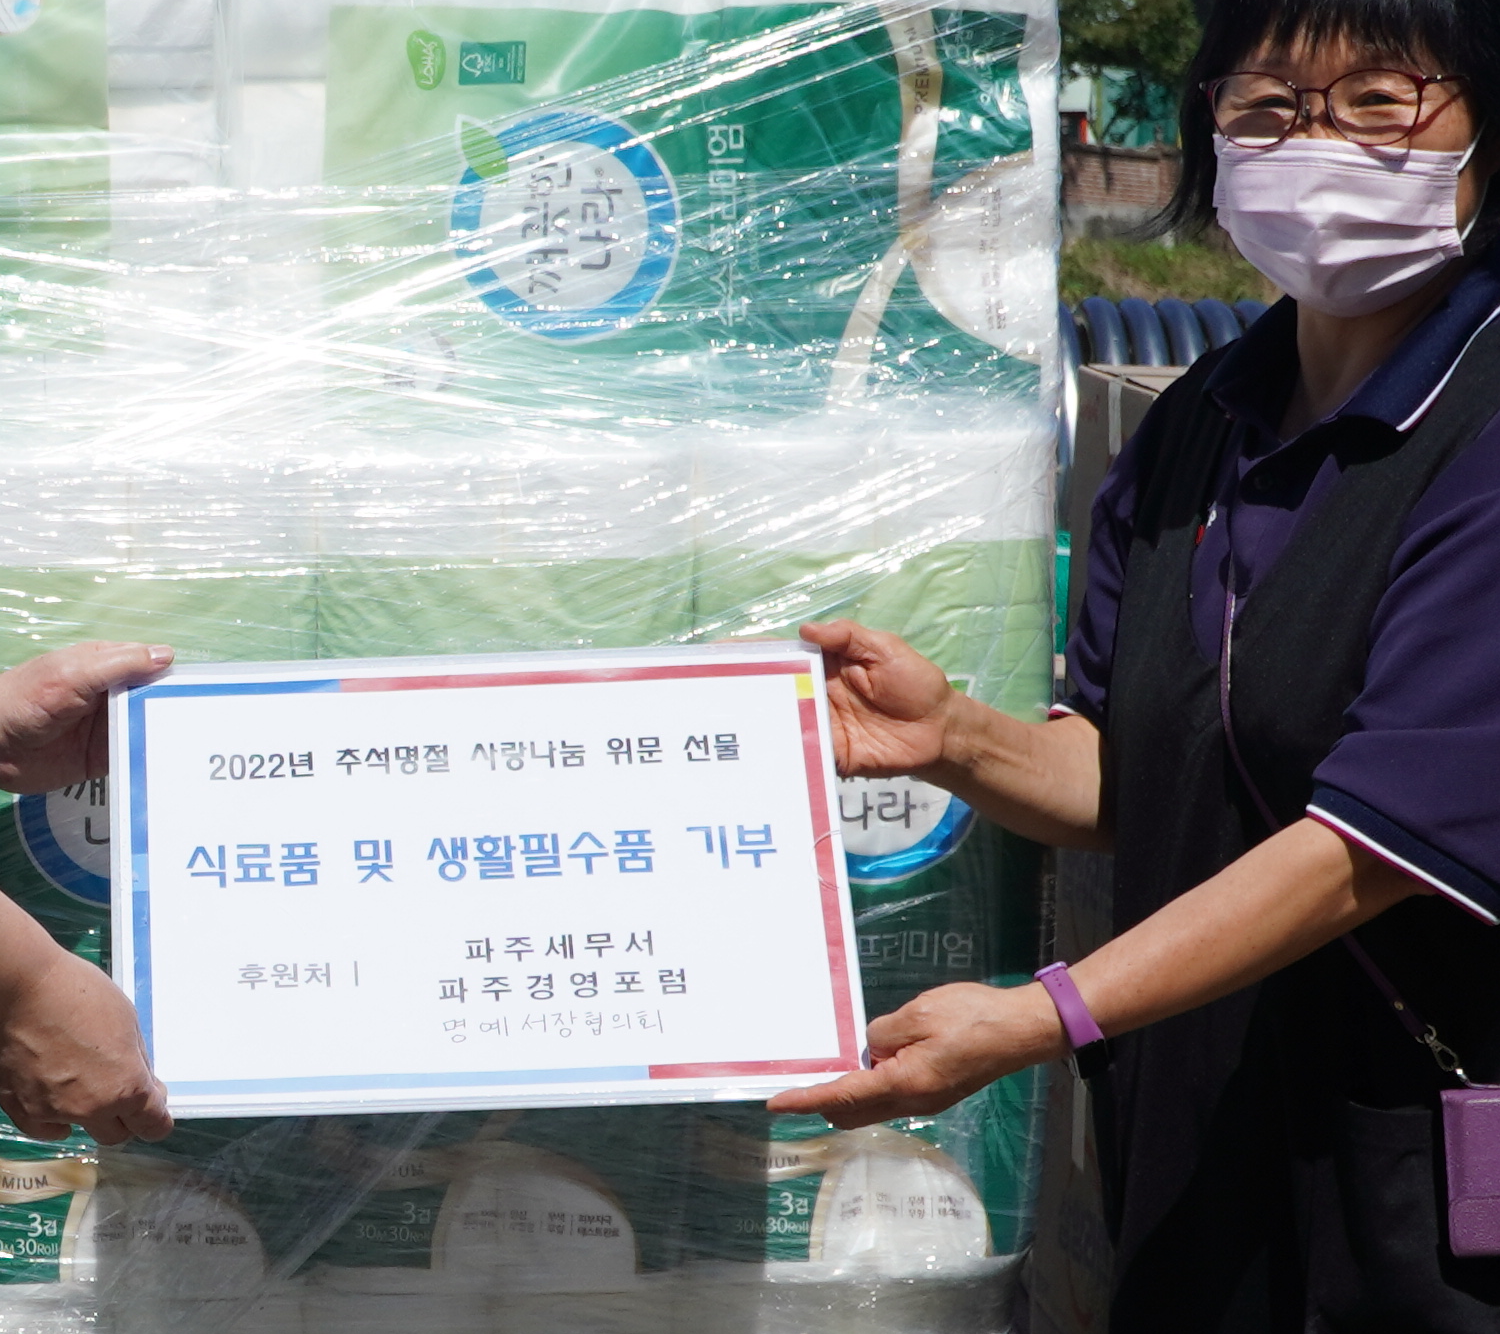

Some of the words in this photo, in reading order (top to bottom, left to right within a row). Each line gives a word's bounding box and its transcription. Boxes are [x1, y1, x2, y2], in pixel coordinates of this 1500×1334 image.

[208, 750, 315, 782] 2022년
[335, 744, 451, 776] 추석명절
[470, 738, 586, 771] 사랑나눔
[605, 735, 664, 765] 위문
[683, 733, 741, 763] 선물
[185, 841, 321, 889] 식료품
[353, 839, 395, 884] 및
[426, 829, 657, 883] 생활필수품
[685, 823, 779, 871] 기부
[464, 929, 655, 964] 파주세무서
[236, 961, 333, 990] 후원처
[437, 967, 688, 1004] 파주경영포럼
[779, 1192, 810, 1216] 3겹
[27, 1212, 58, 1237] 3겹
